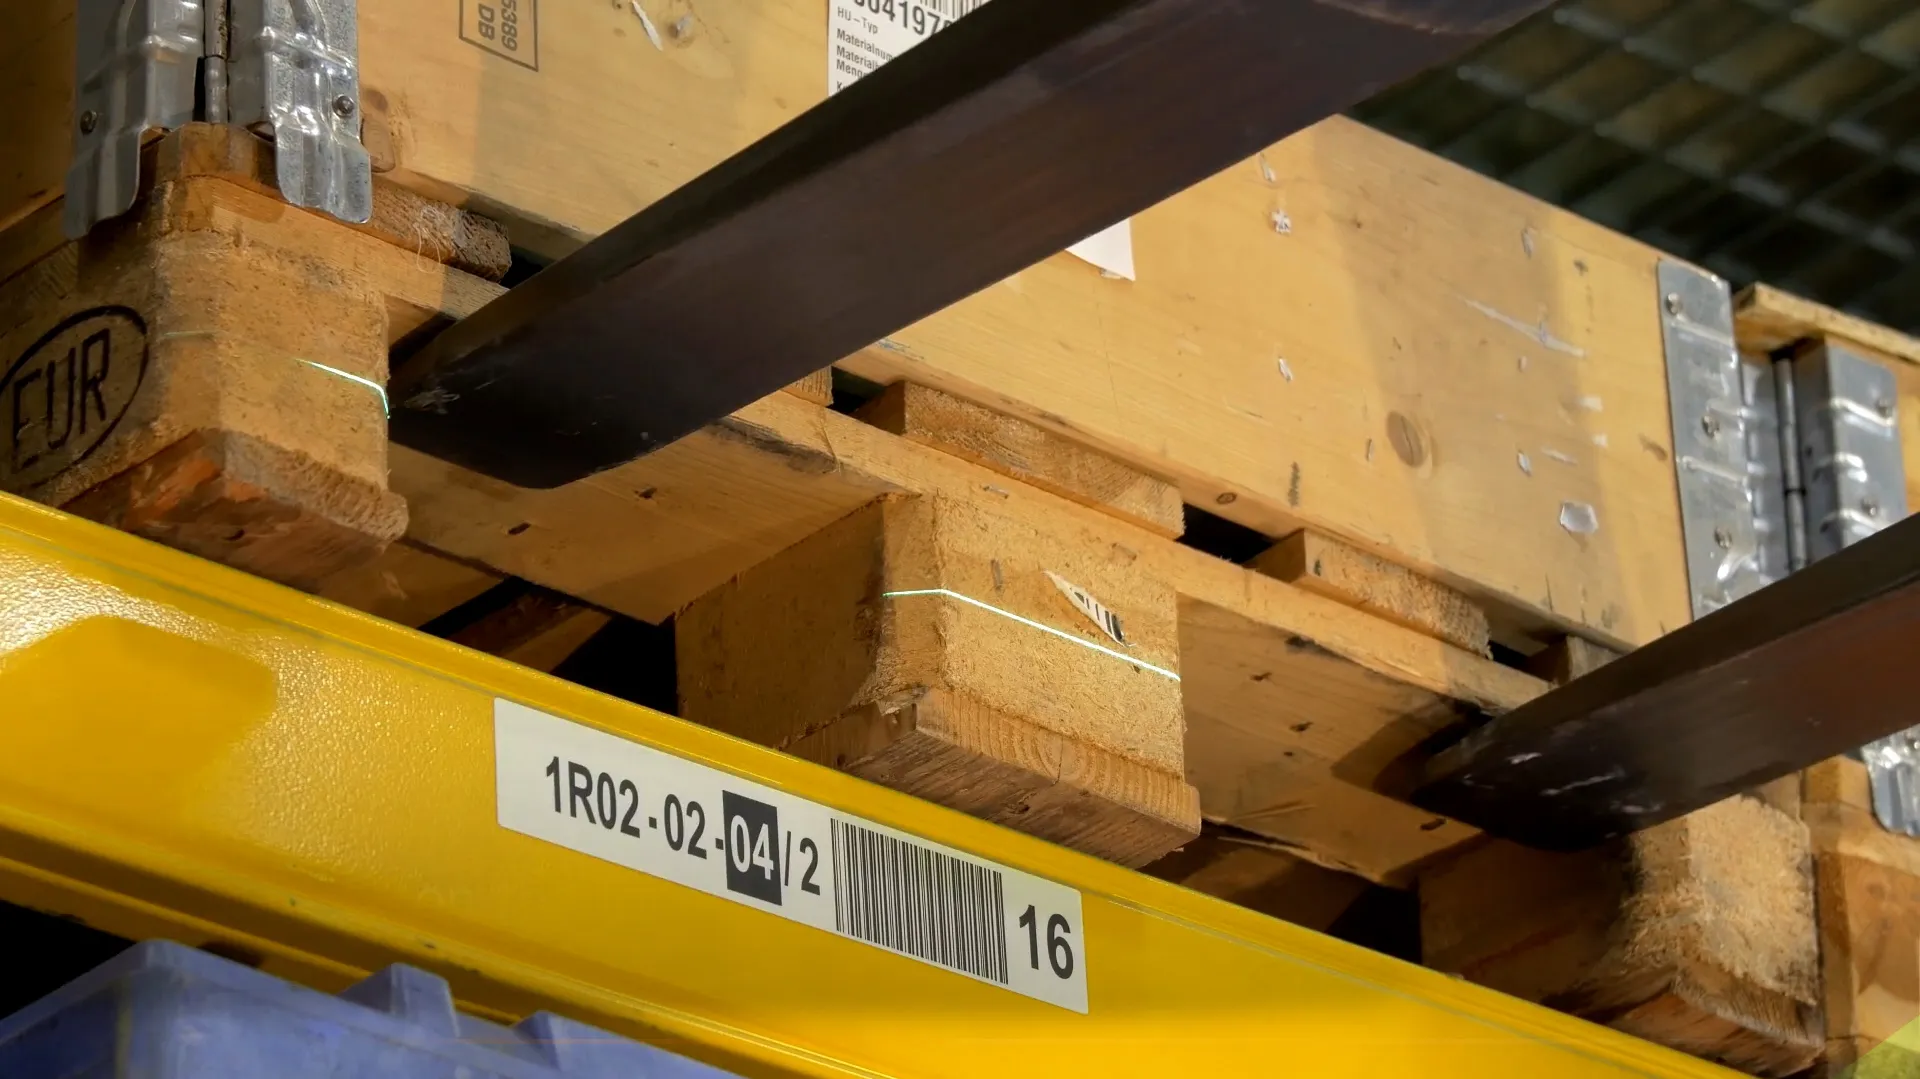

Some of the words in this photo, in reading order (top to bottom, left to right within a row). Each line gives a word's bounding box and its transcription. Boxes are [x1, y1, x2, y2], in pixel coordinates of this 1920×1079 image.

[478, 3, 495, 41] DB
[853, 0, 954, 35] 04197
[12, 328, 110, 472] EUR
[1019, 904, 1074, 980] 16
